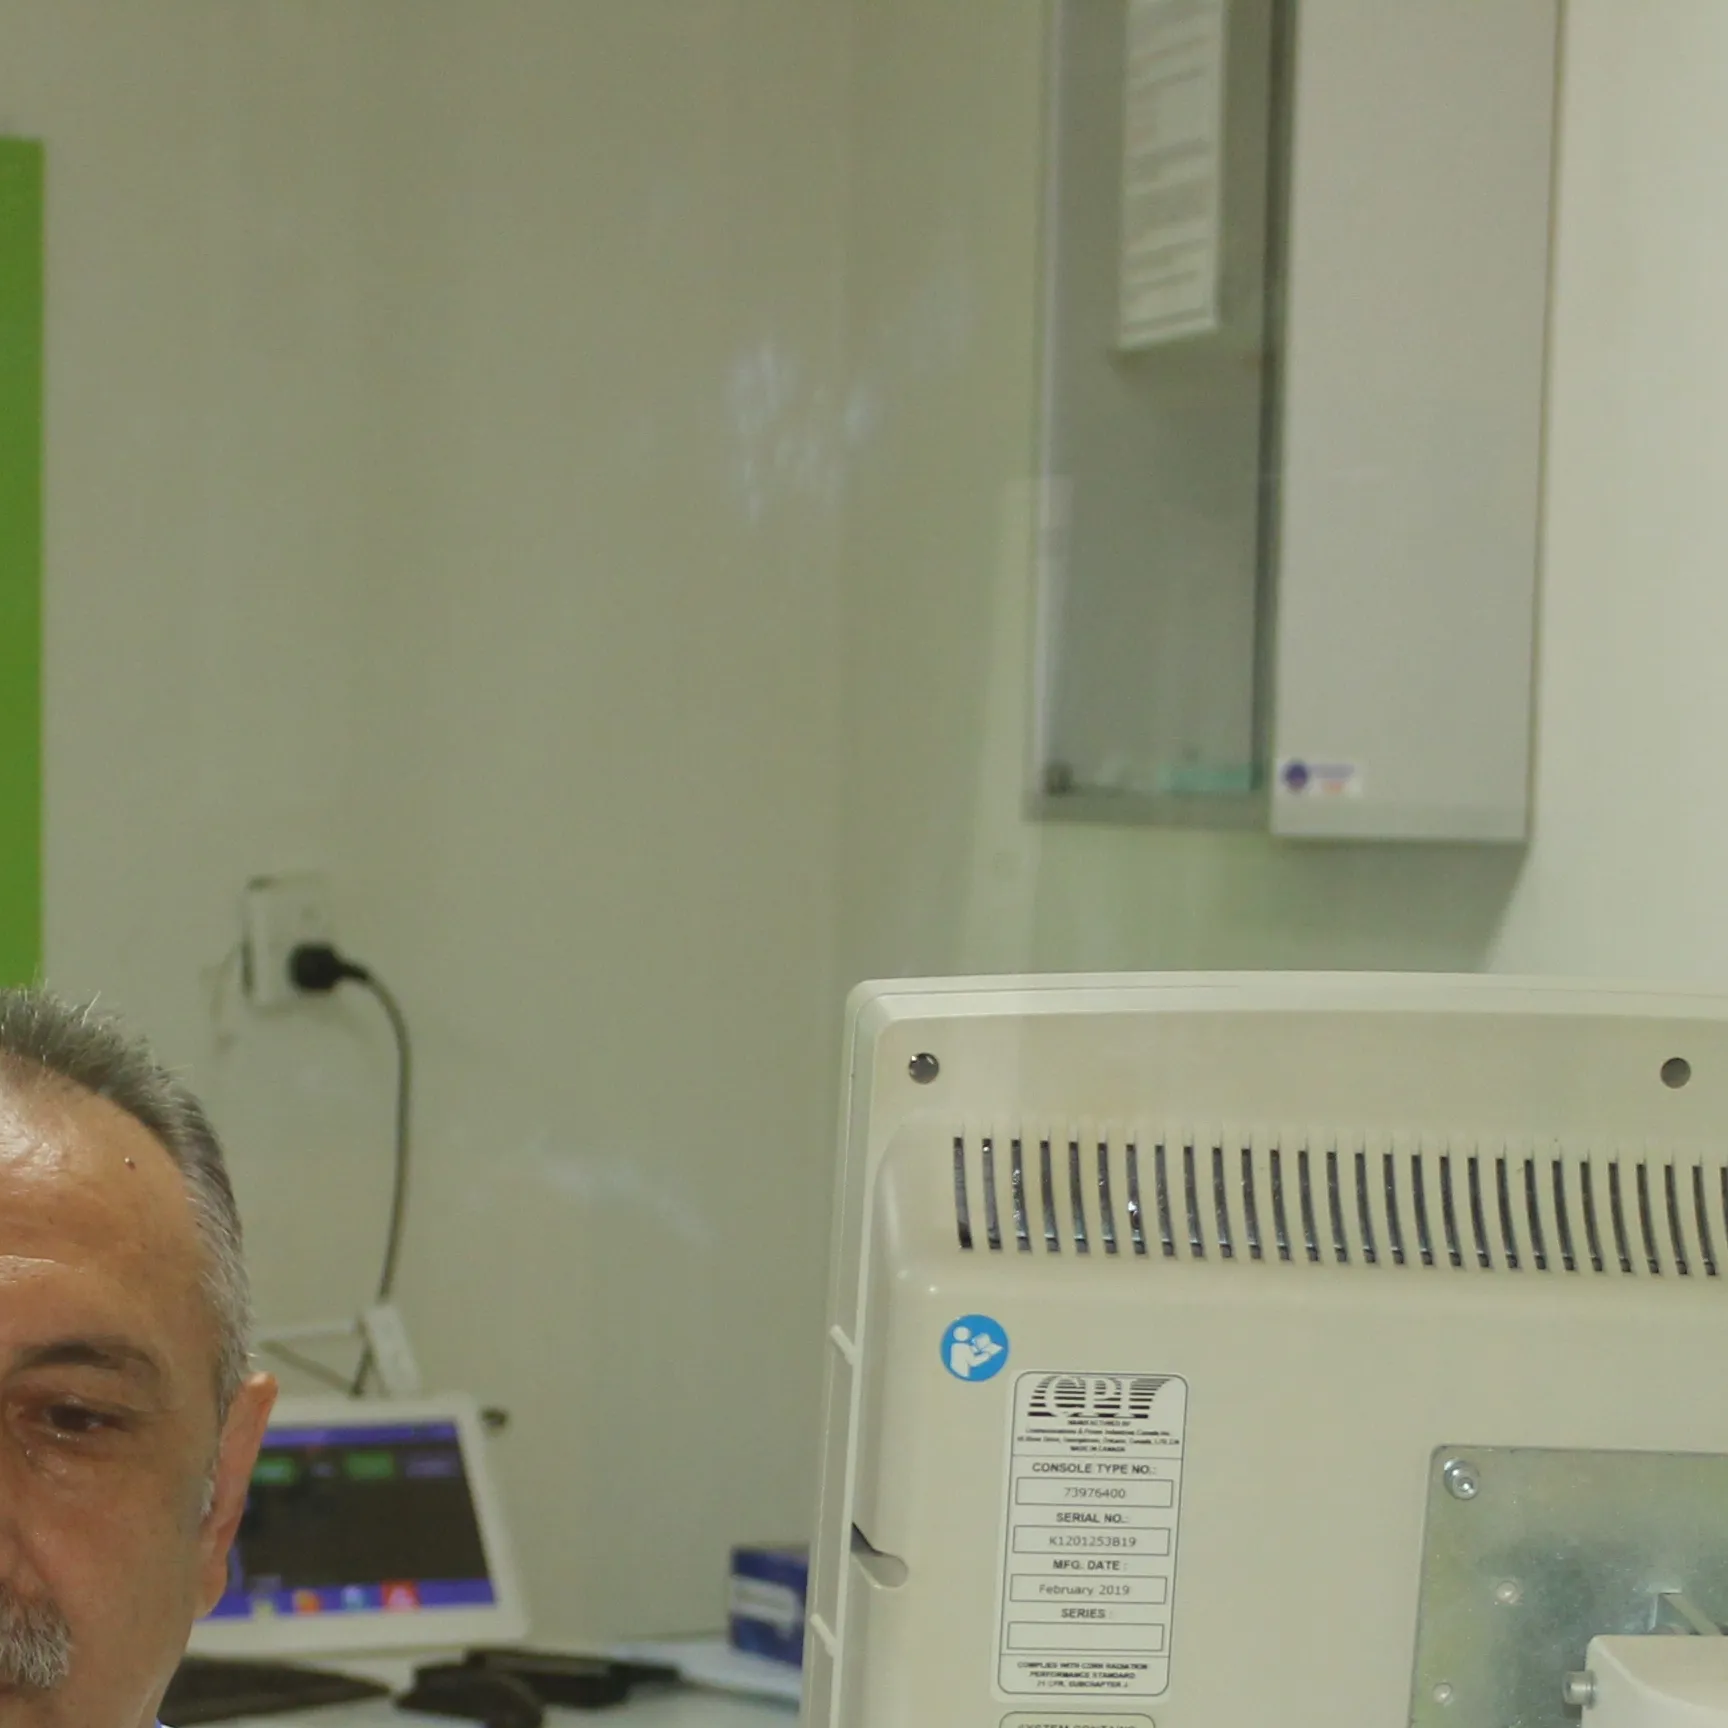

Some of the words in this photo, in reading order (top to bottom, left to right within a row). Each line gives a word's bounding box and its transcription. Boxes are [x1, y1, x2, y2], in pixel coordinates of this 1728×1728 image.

[1032, 1462, 1093, 1474] CONSOLE
[1096, 1463, 1128, 1475] TYPE
[1063, 1487, 1127, 1500] 73976400
[1056, 1512, 1101, 1524] SERIAL
[1039, 1584, 1094, 1597] February
[1098, 1585, 1131, 1597] 2019
